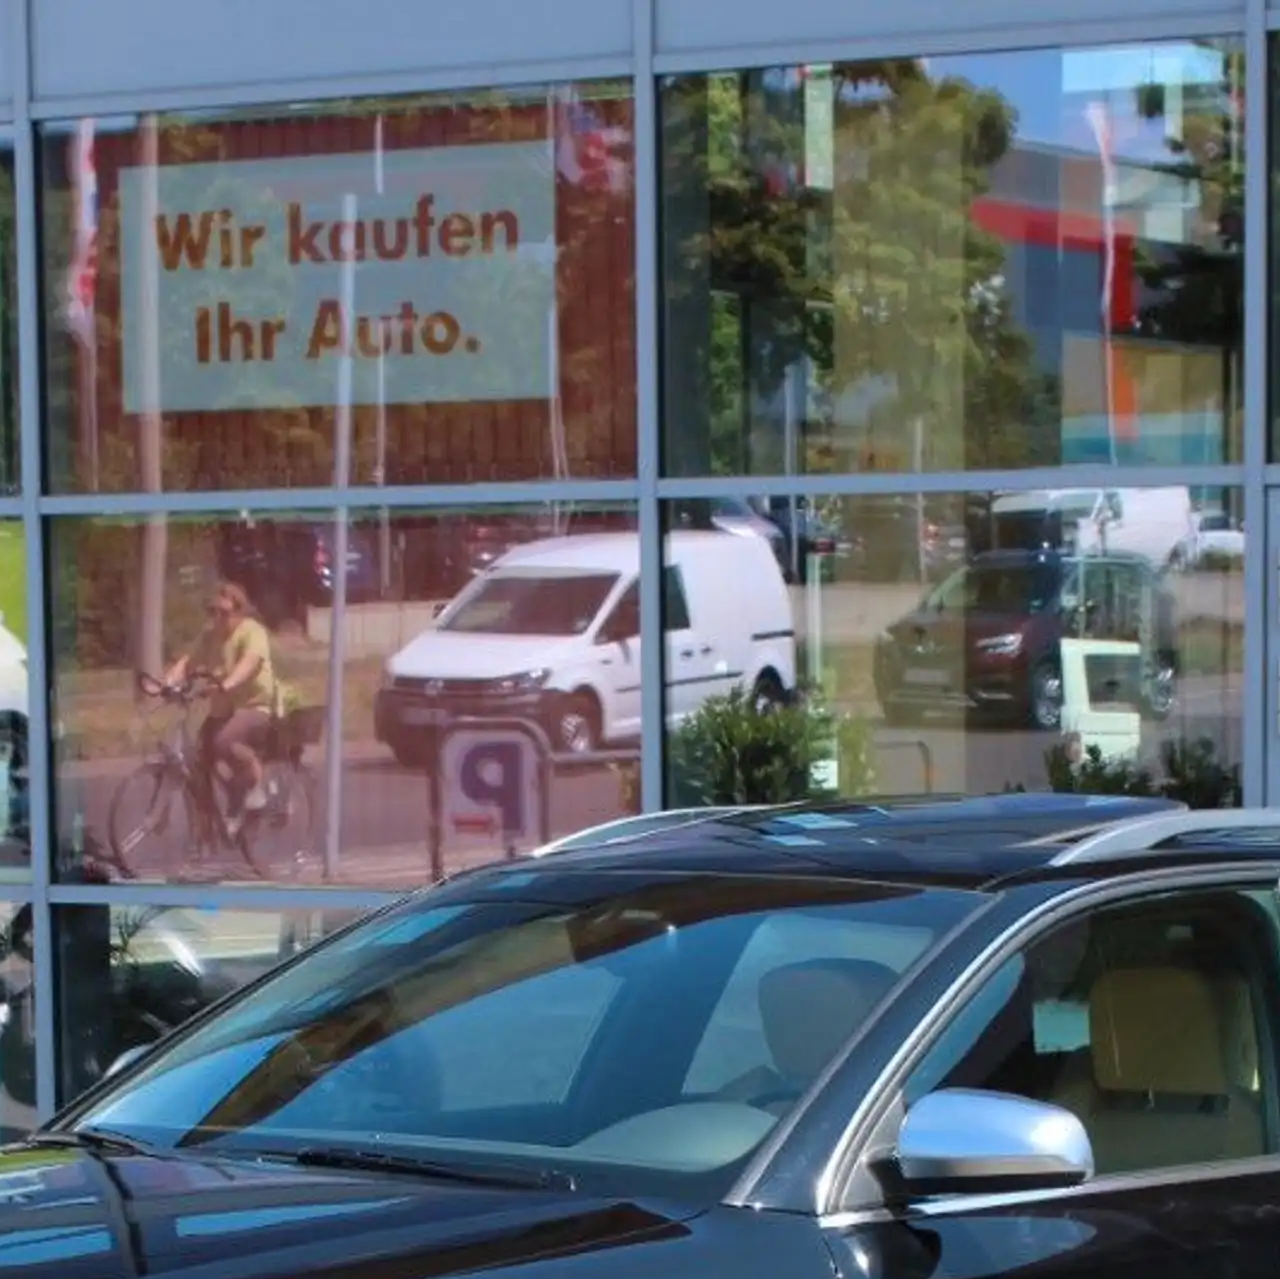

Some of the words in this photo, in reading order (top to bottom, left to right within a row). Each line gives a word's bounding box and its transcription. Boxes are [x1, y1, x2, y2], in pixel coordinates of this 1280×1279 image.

[156, 208, 265, 271] Wir
[288, 193, 519, 264] kaufen
[196, 302, 286, 363] Ihr
[307, 299, 481, 359] Auto.
